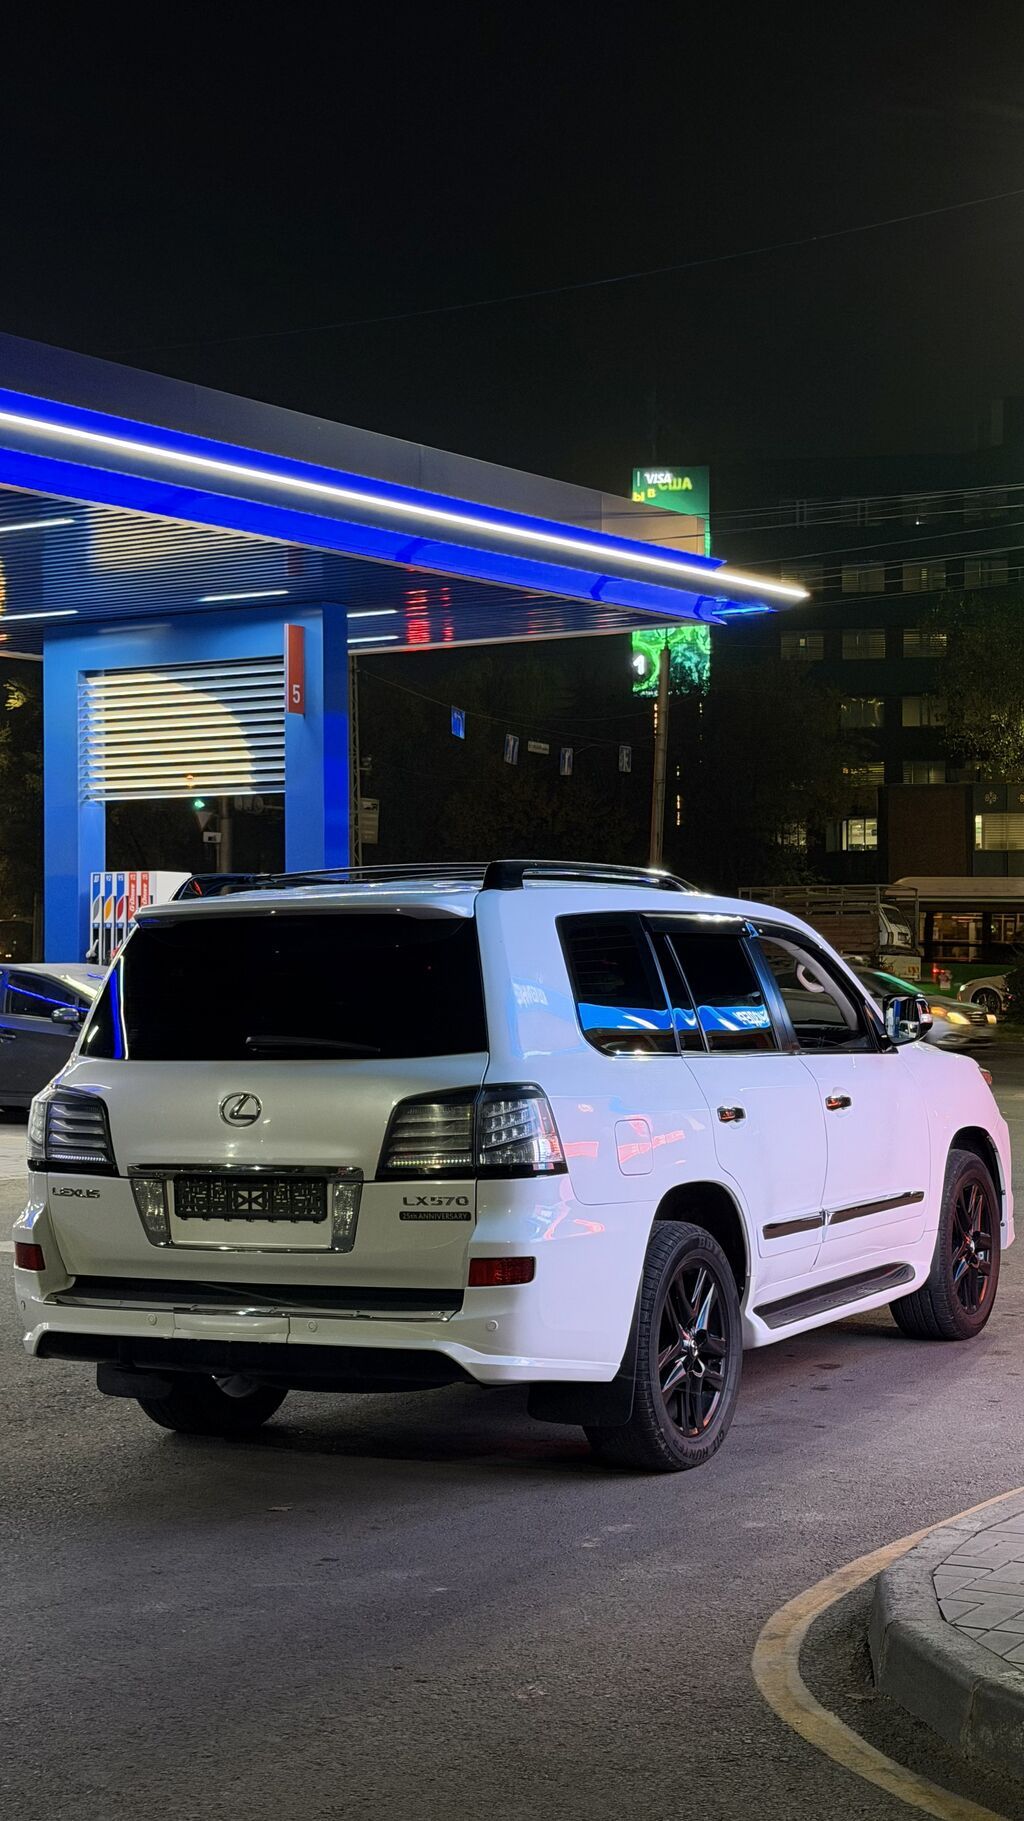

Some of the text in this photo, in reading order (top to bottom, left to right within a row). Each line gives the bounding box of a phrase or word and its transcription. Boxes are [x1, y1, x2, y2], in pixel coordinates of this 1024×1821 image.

[644, 471, 673, 484] VISA
[293, 684, 301, 704] 5
[52, 1187, 100, 1198] LEXUS
[402, 1212, 468, 1220] 25th ANNIVERSARY
